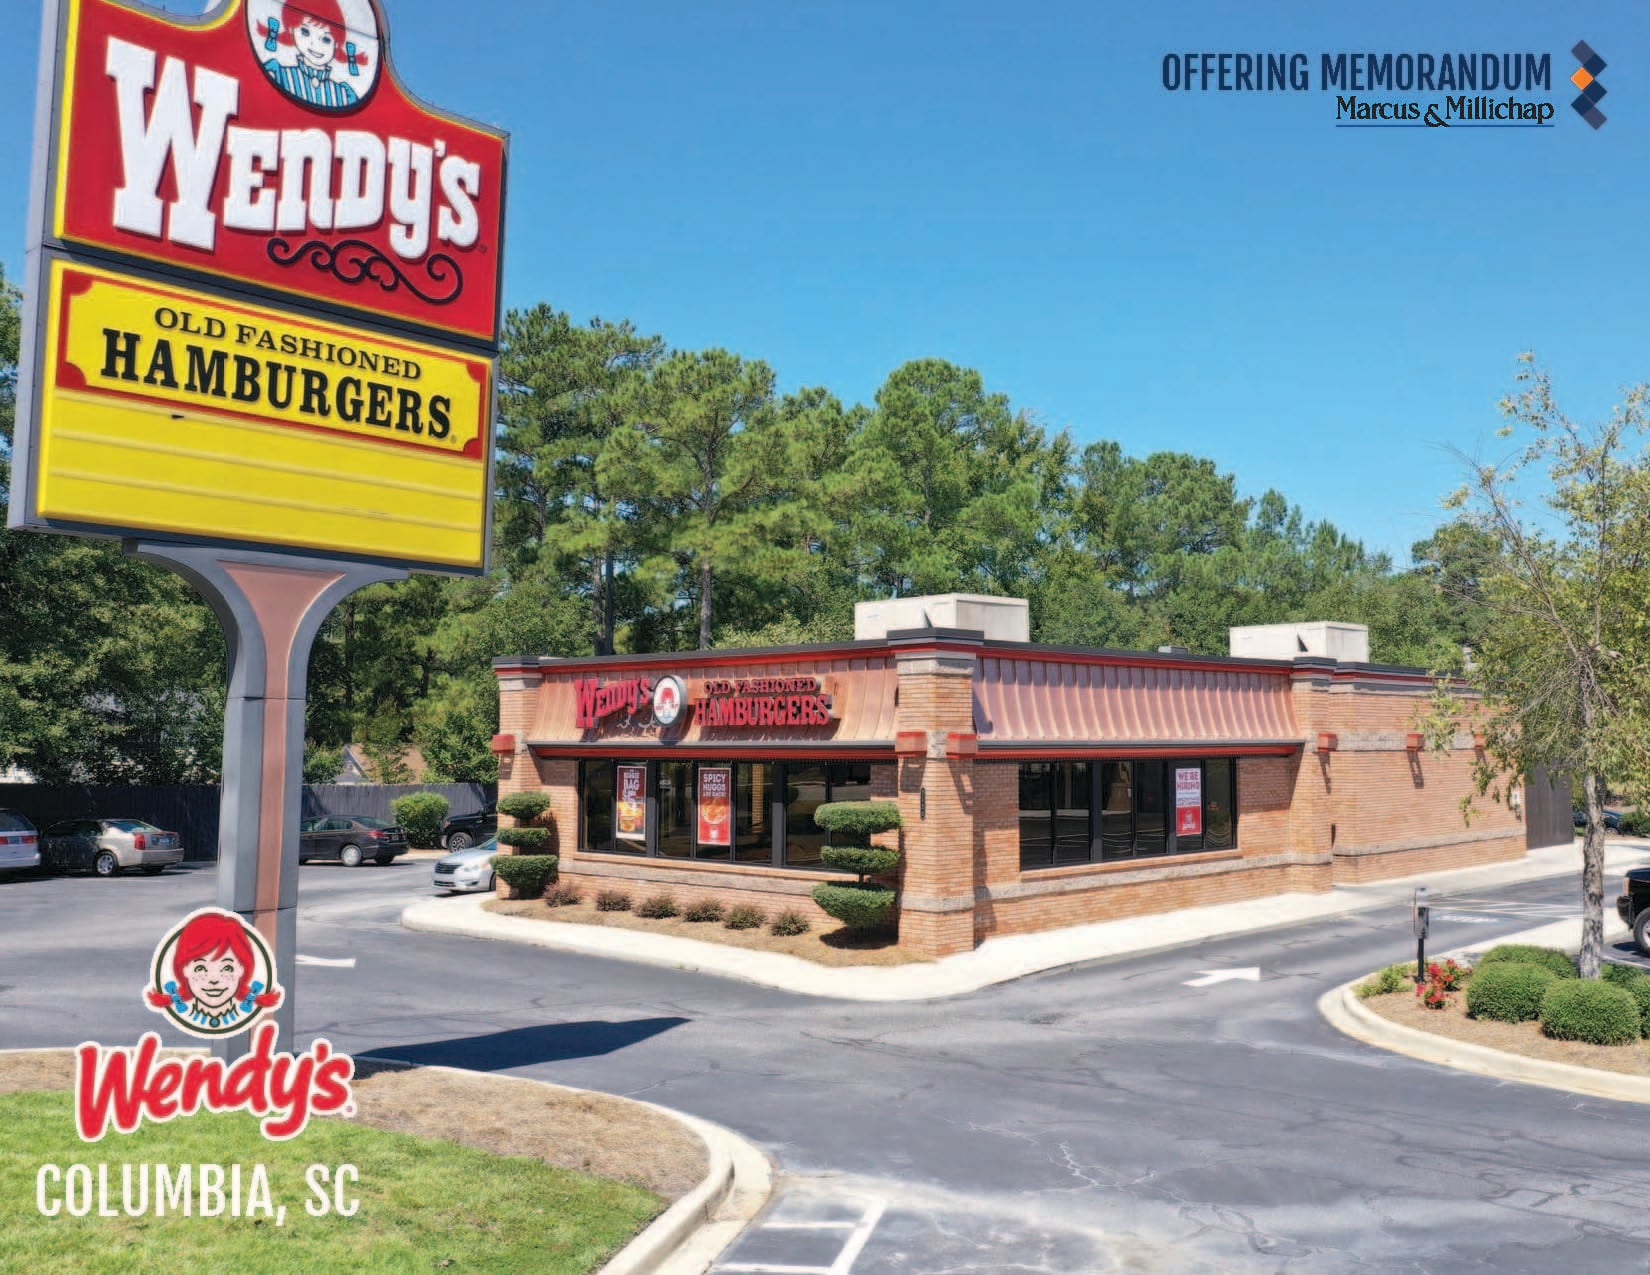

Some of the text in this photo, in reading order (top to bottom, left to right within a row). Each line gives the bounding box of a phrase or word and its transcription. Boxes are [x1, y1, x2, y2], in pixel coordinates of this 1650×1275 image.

[154, 306, 421, 380] OLD FASHIONED
[100, 329, 452, 440] HAMBURGERS
[703, 677, 817, 695] OLD FASHIONED
[694, 694, 830, 727] HAMBURGERS
[703, 773, 726, 783] SPICY
[703, 783, 726, 792] NUGGS
